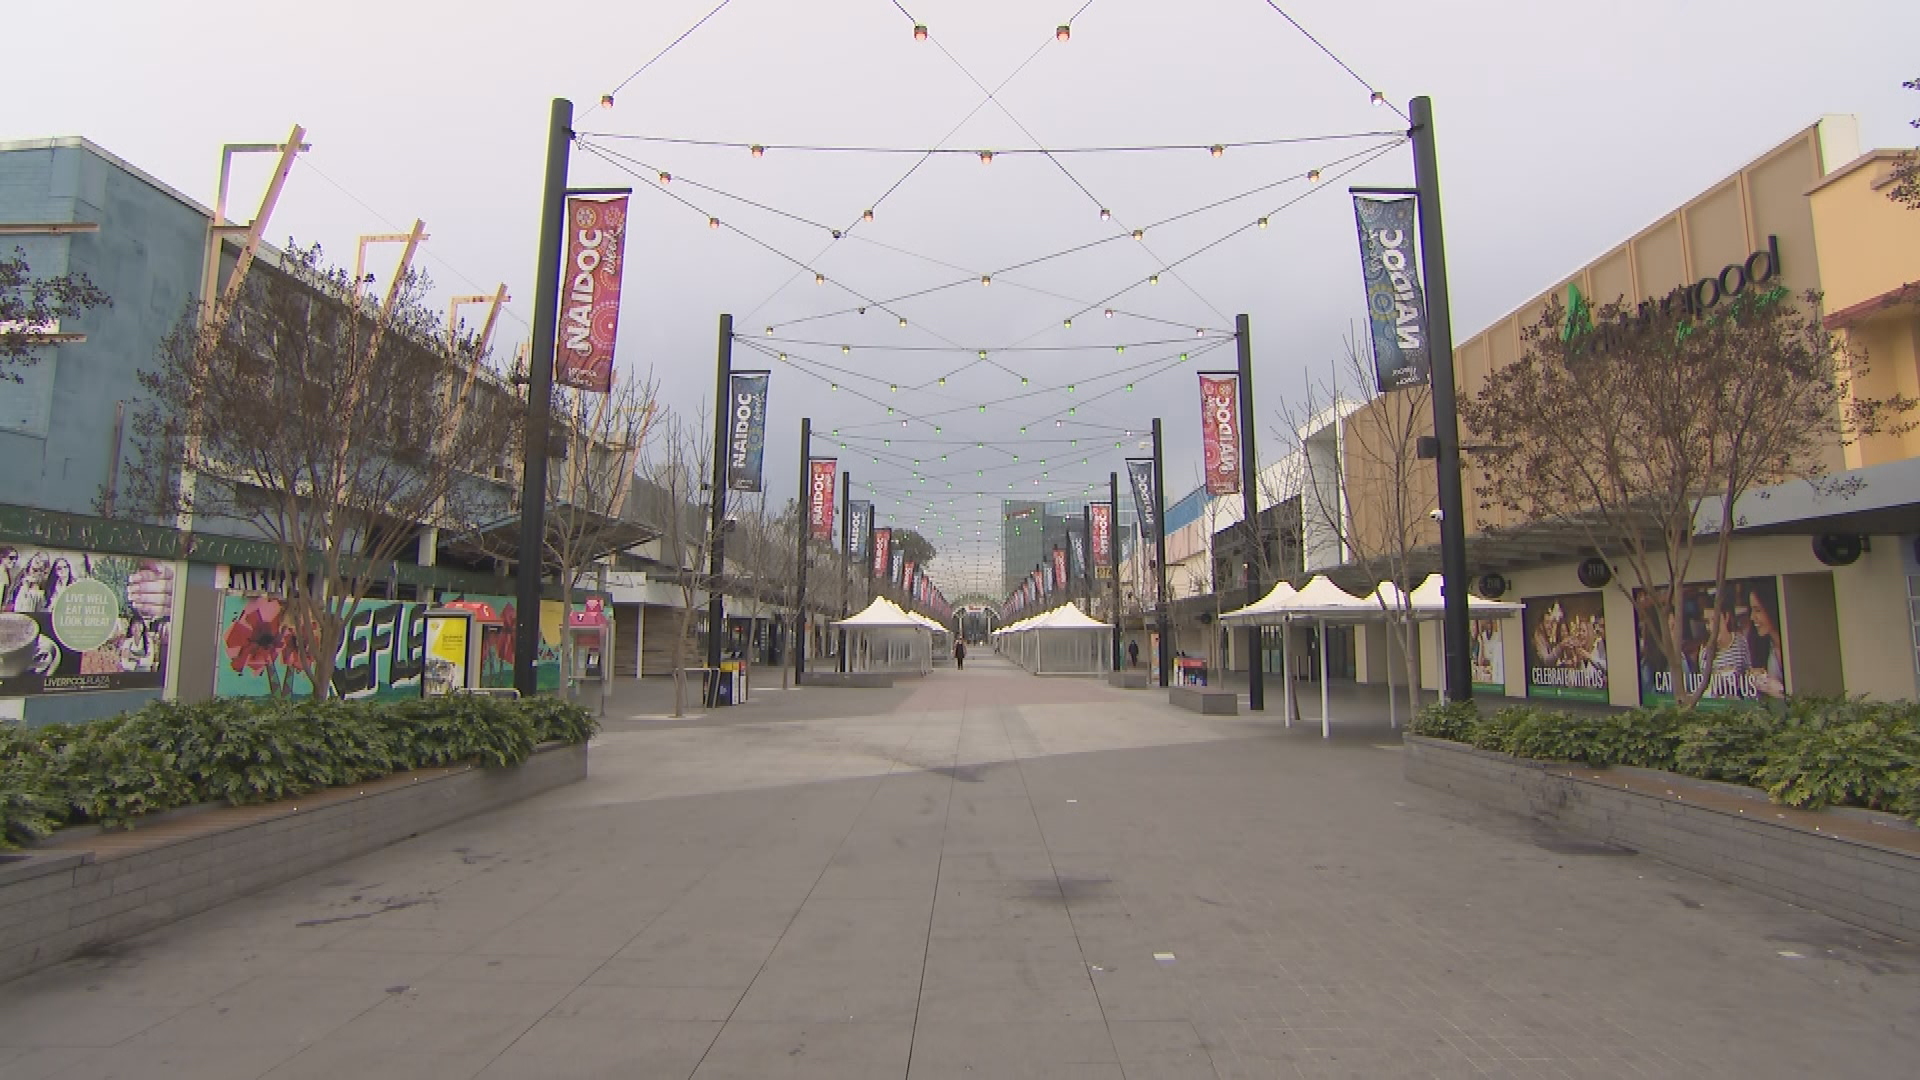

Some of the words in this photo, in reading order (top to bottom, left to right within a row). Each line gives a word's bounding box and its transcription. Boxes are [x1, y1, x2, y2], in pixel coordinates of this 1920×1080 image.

[567, 229, 603, 350] NAIDOC
[733, 393, 752, 468] NAIDOC
[813, 473, 824, 525] NAIDOC
[850, 511, 861, 552] NAIDOC
[66, 593, 84, 603] LIVE
[87, 593, 108, 604] WELL
[66, 605, 81, 615] EAT
[85, 605, 105, 615] WELL
[60, 616, 82, 627] LOOK
[85, 617, 109, 627] GREAT
[1532, 667, 1568, 685] CELEBRATE
[1569, 669, 1590, 687] WITH
[1592, 670, 1604, 688] US
[1655, 671, 1687, 692] CAT
[1740, 673, 1757, 697] US
